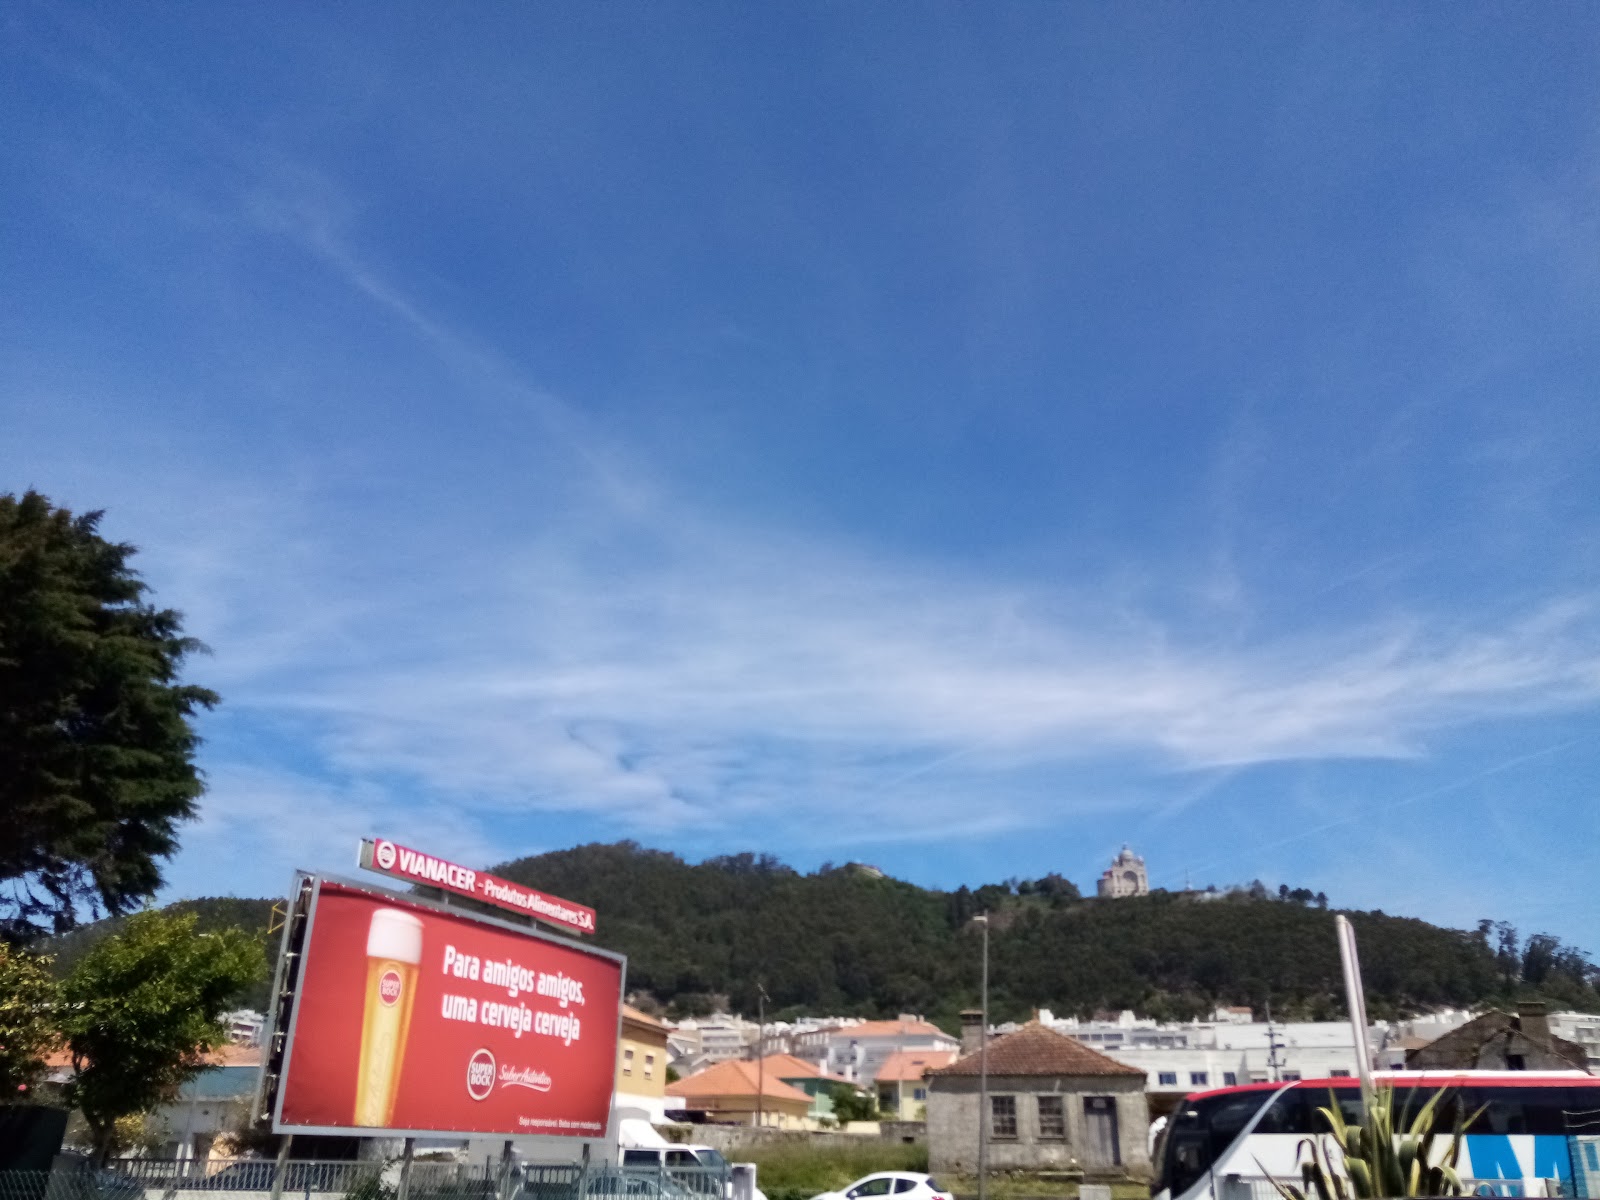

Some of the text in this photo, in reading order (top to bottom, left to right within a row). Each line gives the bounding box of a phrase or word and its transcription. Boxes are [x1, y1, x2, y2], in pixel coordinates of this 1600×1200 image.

[399, 848, 476, 891] VIANACER
[484, 879, 528, 908] Produtos
[442, 945, 585, 1008] Para amigos amigos,
[441, 994, 580, 1046] uma cerveja cerveja
[470, 1073, 491, 1087] BOCK
[471, 1062, 493, 1076] SUPER
